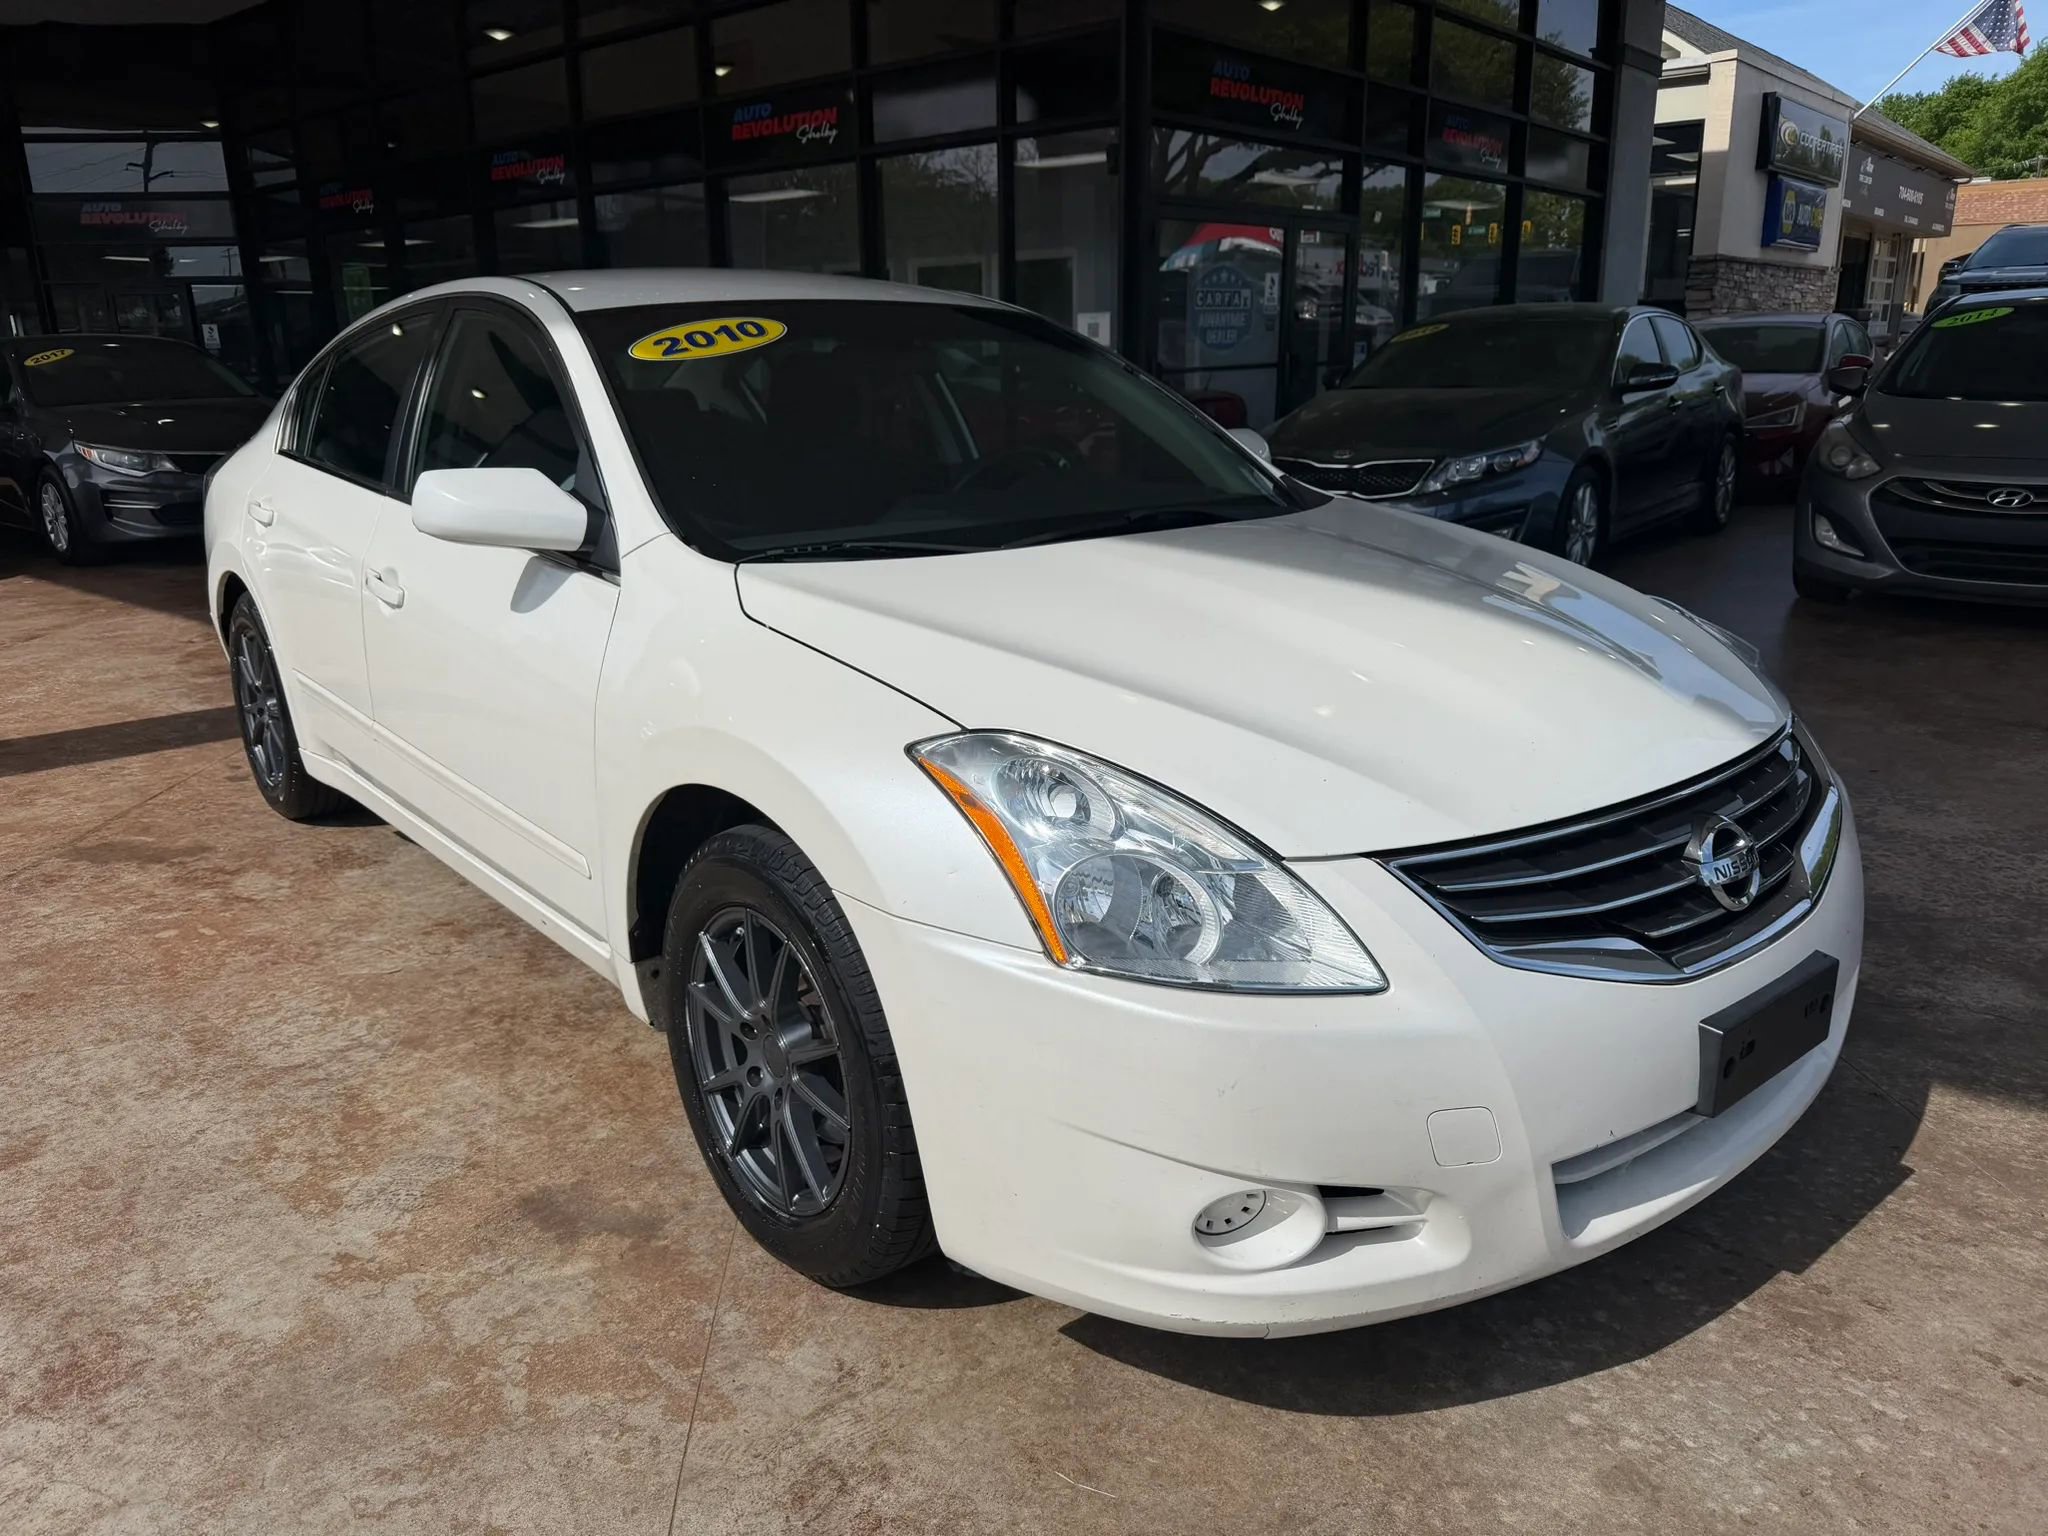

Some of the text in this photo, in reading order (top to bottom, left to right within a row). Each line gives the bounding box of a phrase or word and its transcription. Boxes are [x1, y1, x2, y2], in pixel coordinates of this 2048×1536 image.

[1214, 59, 1250, 80] AUTO
[1210, 77, 1304, 111] REVOLUTION
[732, 106, 838, 141] REVOLUTION
[733, 102, 772, 123] AUTO
[1270, 102, 1304, 130] Shelby
[796, 120, 838, 144] Shelby
[490, 153, 566, 181] REVOLUTION
[81, 201, 123, 213] AUTO
[1947, 309, 1998, 325] 2014
[652, 320, 769, 357] 2010
[30, 350, 65, 364] 2017
